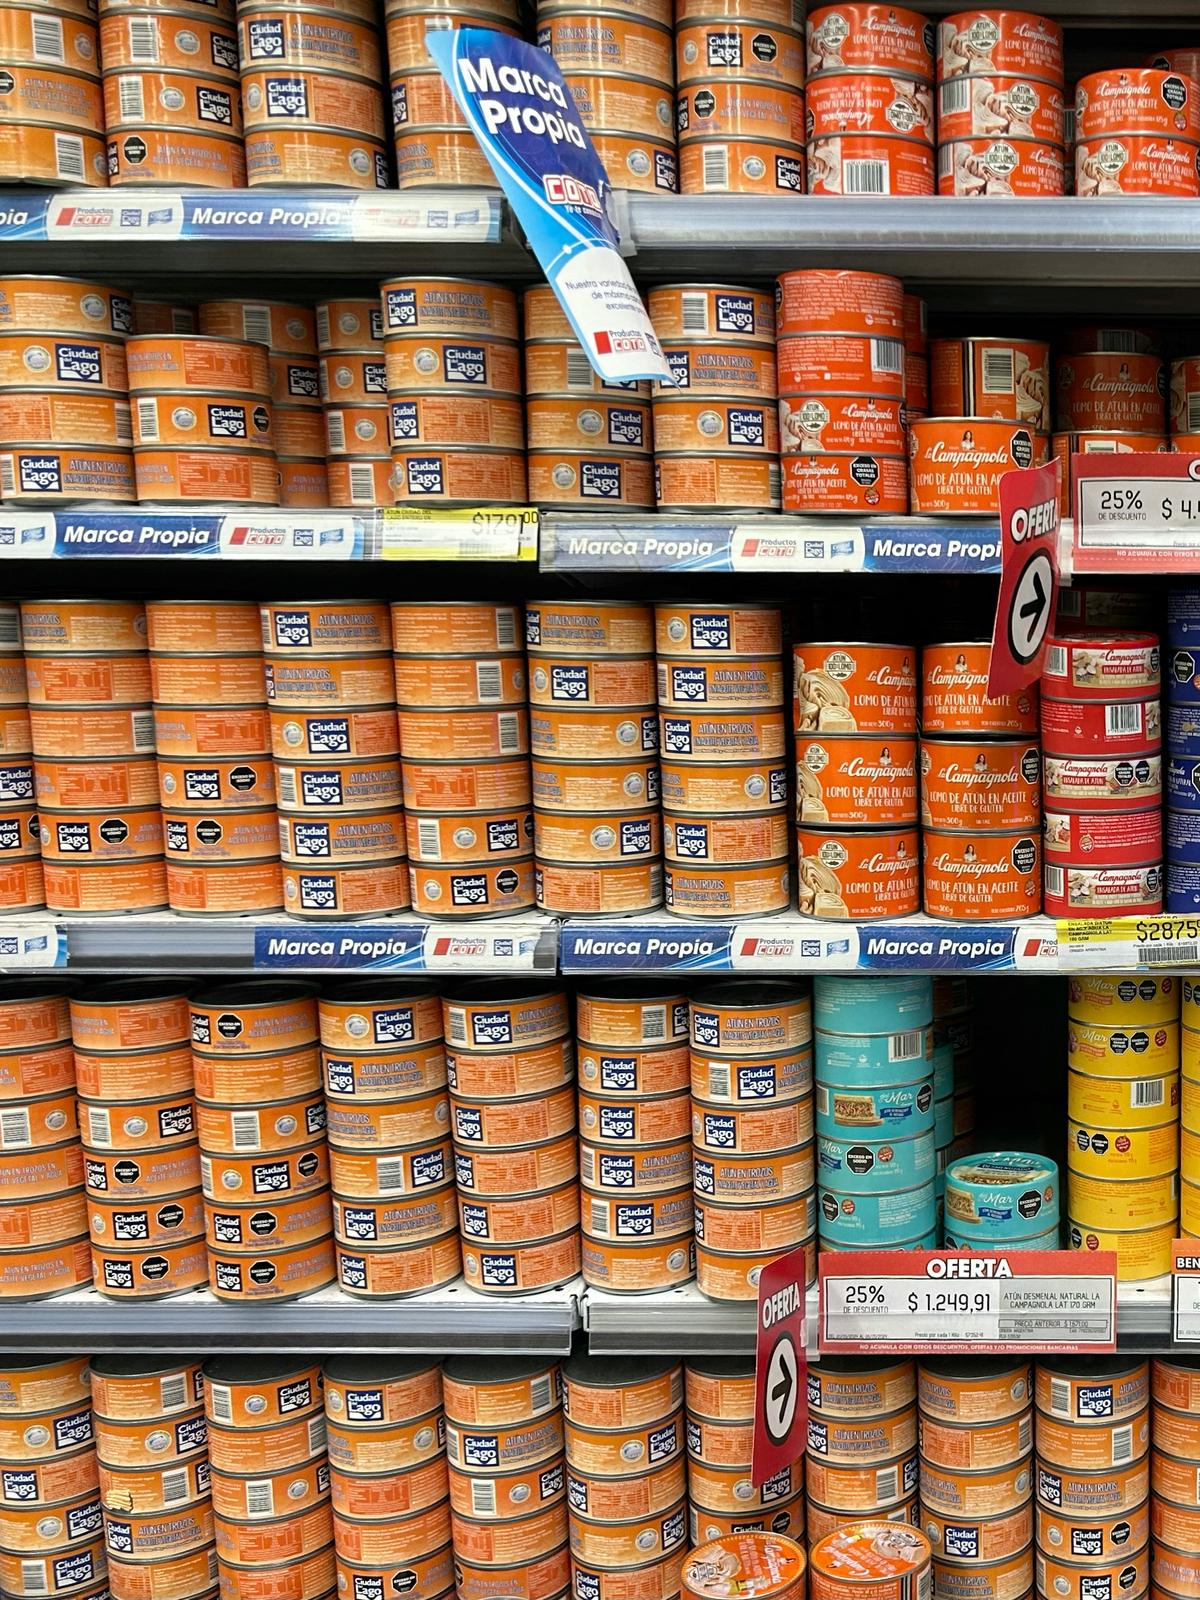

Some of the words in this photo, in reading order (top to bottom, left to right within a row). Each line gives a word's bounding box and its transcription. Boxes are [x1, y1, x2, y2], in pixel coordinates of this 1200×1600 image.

[268, 81, 305, 94] Ciudad
[459, 58, 568, 110] Marca
[269, 95, 306, 108] Lago
[480, 99, 587, 150] Propia
[191, 208, 262, 225] Marca
[268, 208, 340, 230] Propia
[58, 348, 99, 360] Ciudad
[60, 360, 100, 374] Lago
[1101, 490, 1143, 510] 25%
[1162, 498, 1172, 520] $
[63, 525, 132, 543] Marca
[138, 526, 210, 548] Propia
[760, 538, 797, 546] Productos
[568, 536, 640, 556] Marca
[644, 538, 714, 560] Propia
[757, 546, 797, 557] COTO
[873, 539, 933, 558] Marca
[937, 541, 1001, 561] Propi
[692, 618, 728, 629] Ciudad
[693, 628, 727, 642] Lago
[945, 763, 1019, 789] Campagnola
[930, 792, 948, 801] LOMO
[949, 792, 959, 803] DE
[989, 792, 999, 804] EN
[1002, 792, 1026, 803] ACEITE
[1136, 921, 1198, 942] $2875
[268, 938, 335, 955] Marca
[340, 938, 407, 959] Propia
[574, 938, 640, 955] Marca
[646, 939, 714, 959] Propia
[867, 938, 934, 955] Marca
[939, 939, 1005, 959] Propia
[375, 1012, 413, 1025] Ciudad
[377, 1023, 412, 1037] Lago
[926, 1259, 1012, 1278] OFERTA
[846, 1286, 885, 1303] 25%
[908, 1292, 918, 1313] $
[926, 1293, 991, 1313] 1.249,91
[1004, 1292, 1021, 1300] ATÚN
[762, 1281, 801, 1328] OFERTA
[1193, 1302, 1200, 1310] DE
[1079, 1388, 1112, 1400] Ciudad
[1079, 1398, 1111, 1412] Lago
